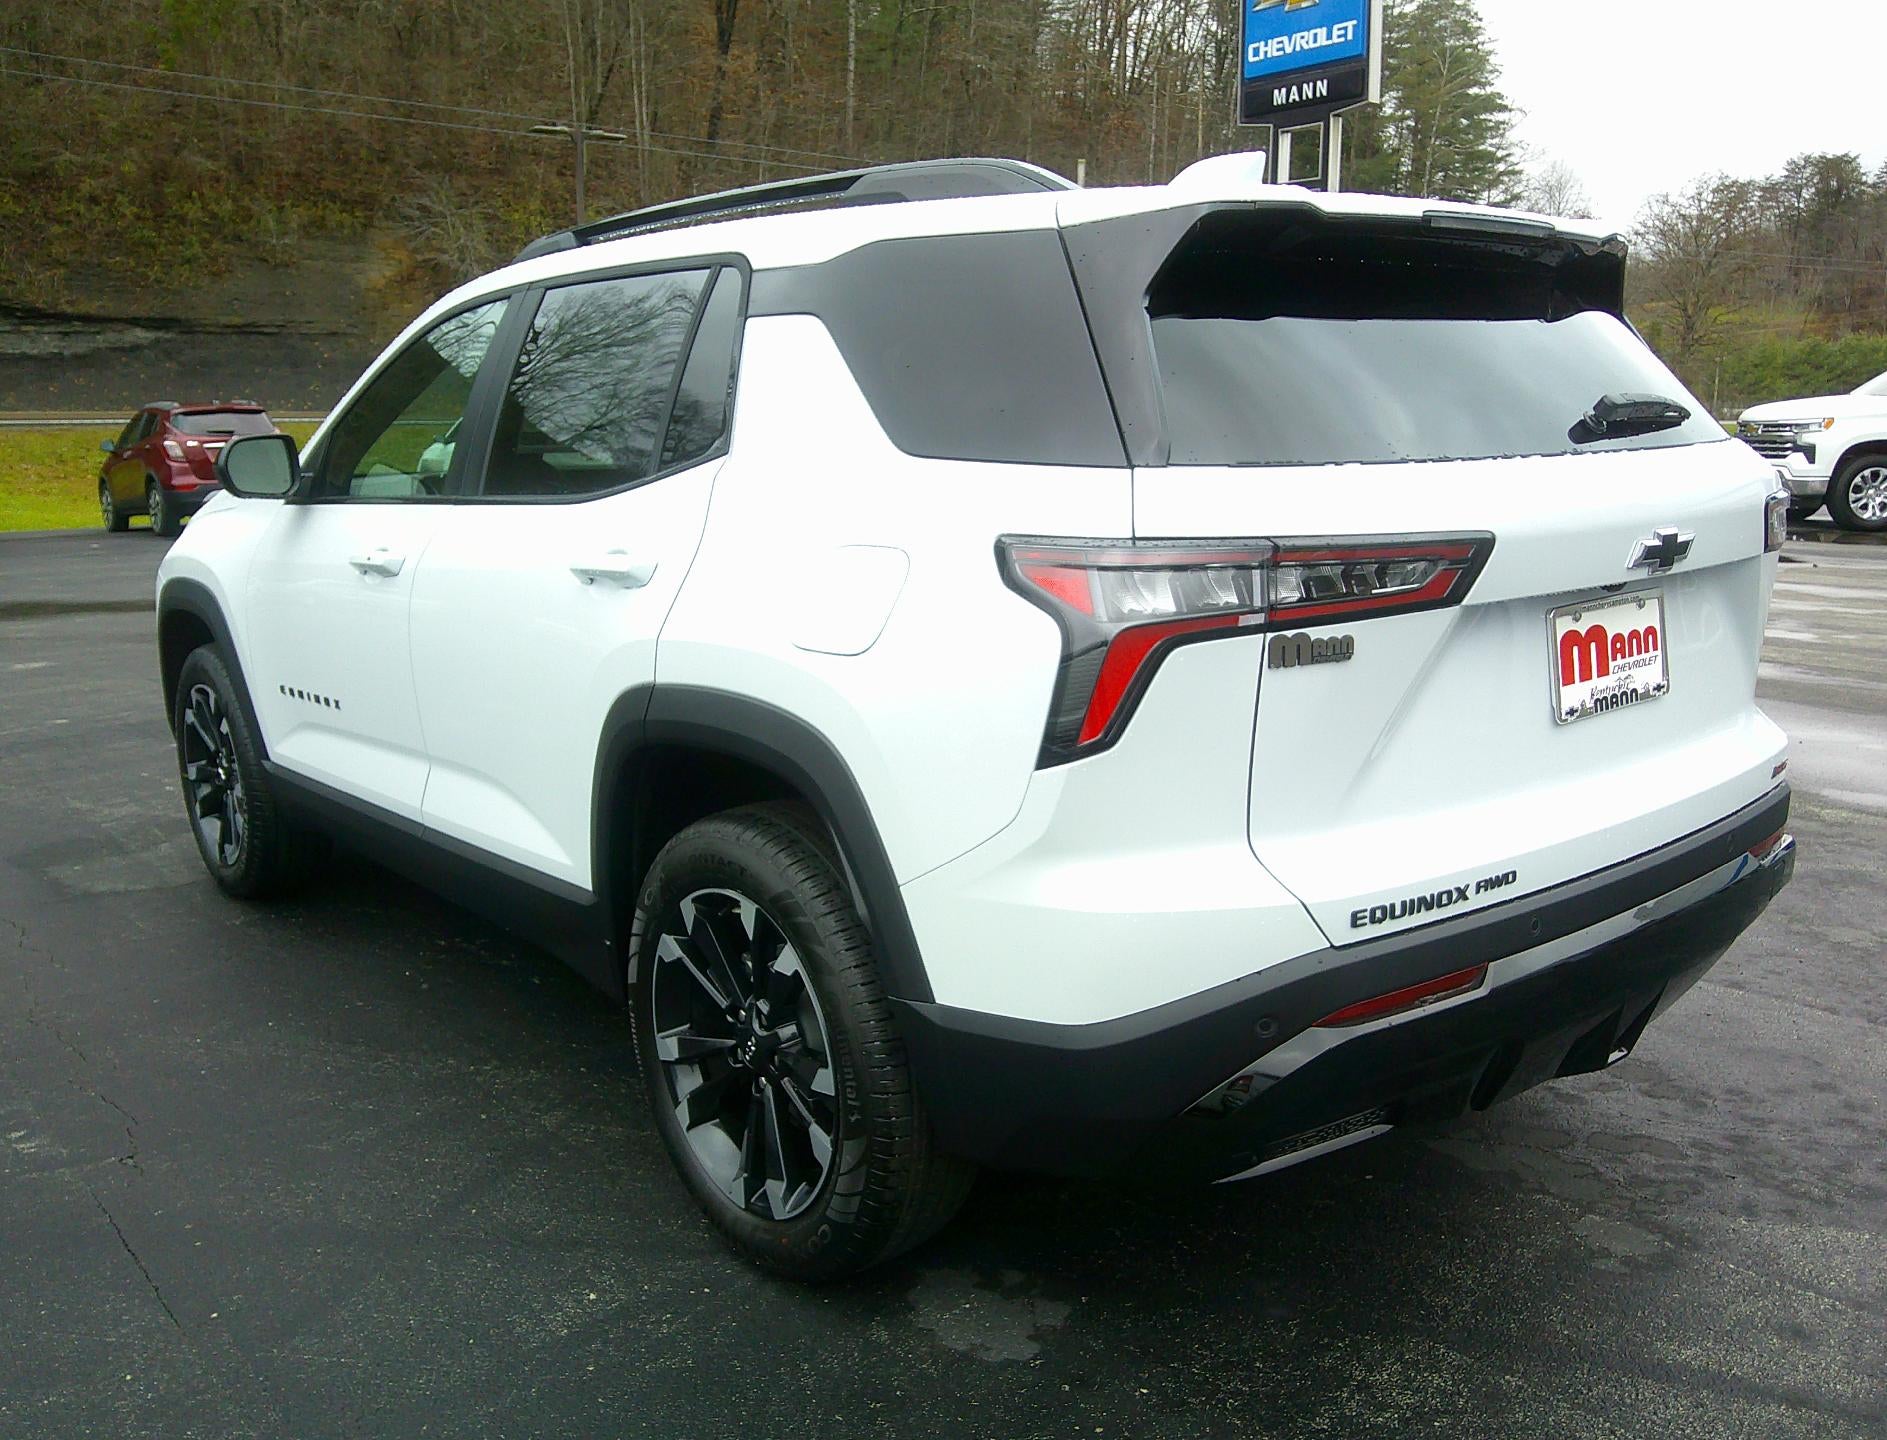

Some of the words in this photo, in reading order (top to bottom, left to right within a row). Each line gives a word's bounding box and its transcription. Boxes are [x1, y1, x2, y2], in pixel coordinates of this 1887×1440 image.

[1247, 19, 1358, 63] CHEVROLET
[1272, 78, 1329, 107] MANN
[1611, 654, 1659, 675] CHEVROLET
[1350, 883, 1470, 929] EQUINOX
[1475, 869, 1518, 895] AWD
